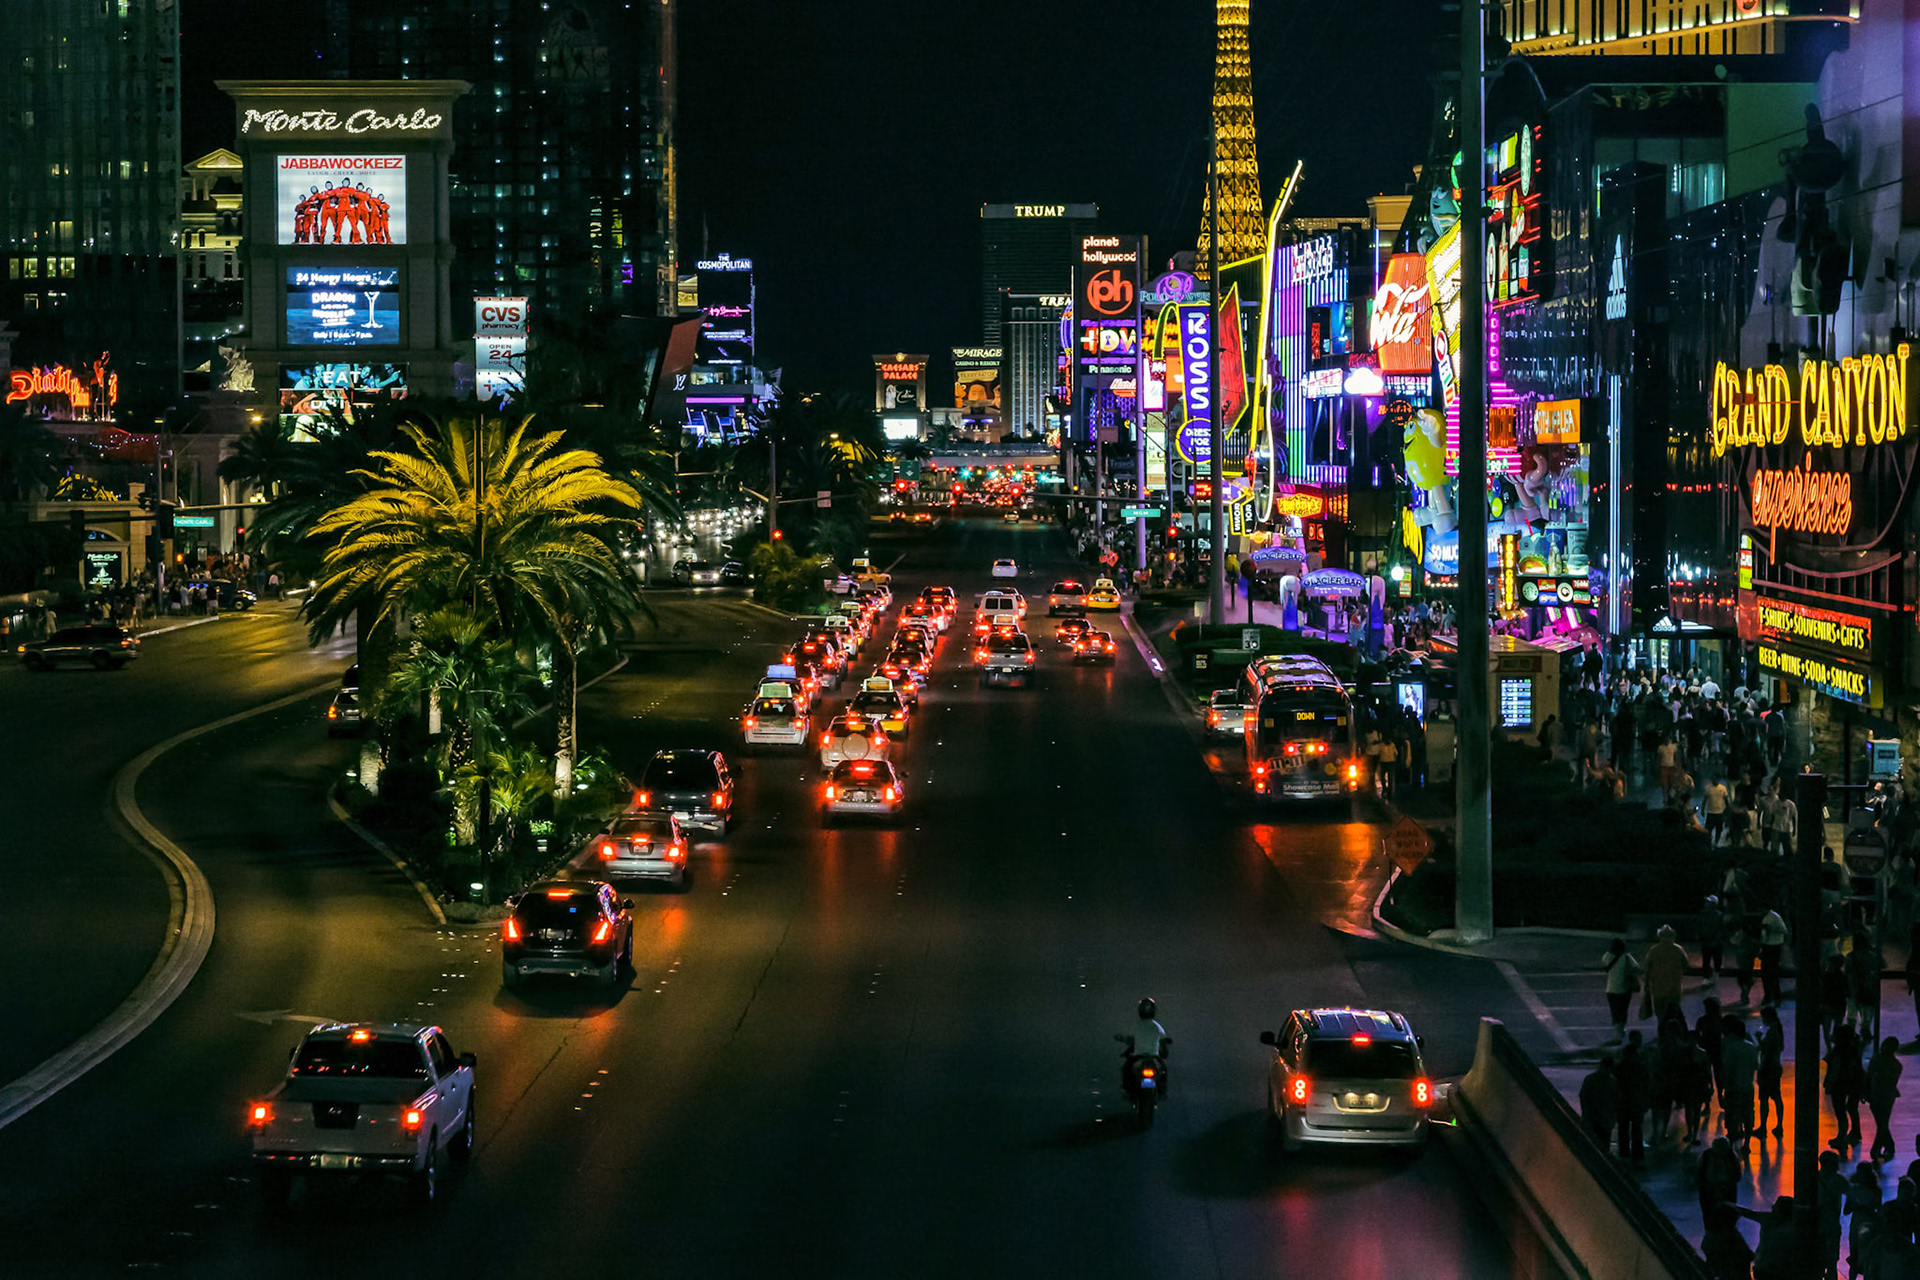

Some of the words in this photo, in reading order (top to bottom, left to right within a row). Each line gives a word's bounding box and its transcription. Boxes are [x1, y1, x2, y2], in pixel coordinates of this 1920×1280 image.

[242, 109, 342, 133] Monte
[345, 108, 442, 133] Carlo
[281, 158, 403, 169] JABBAWOCKEEZ
[1015, 205, 1065, 217] TRUMP
[1083, 235, 1119, 248] planet
[1083, 251, 1137, 264] hollywood
[698, 261, 750, 269] COSMOPOLITAN
[296, 273, 309, 282] 24
[310, 273, 341, 283] Happy
[343, 273, 371, 282] Hours
[1092, 270, 1134, 300] ph
[1039, 296, 1072, 307] TREA
[481, 307, 520, 322] CVS
[482, 322, 520, 330] pharmacy
[489, 350, 512, 360] 24
[960, 349, 1003, 358] MIRAGE
[1187, 312, 1210, 410] ROSS
[881, 364, 919, 372] CAESARS
[1089, 365, 1132, 374] Panasonic
[323, 371, 361, 384] EAT
[883, 372, 918, 380] PALACE
[1712, 360, 1792, 458] GRAND
[1800, 343, 1909, 449] CANYON
[1752, 450, 1852, 565] experience
[1431, 544, 1442, 560] SO
[1443, 544, 1458, 561] MUC
[1505, 534, 1514, 568] FOOD
[1304, 576, 1342, 586] GLACIER
[1344, 576, 1362, 586] BAR
[1758, 606, 1790, 631] T-SHIRTS
[1793, 614, 1836, 644] SOUVENIRS
[1840, 625, 1864, 650] GIFTS
[1758, 646, 1778, 669] BEER
[1781, 653, 1802, 677] WINE
[1805, 659, 1827, 685] SODA
[1830, 666, 1864, 696] SNACKS
[1296, 712, 1315, 720] DOWN
